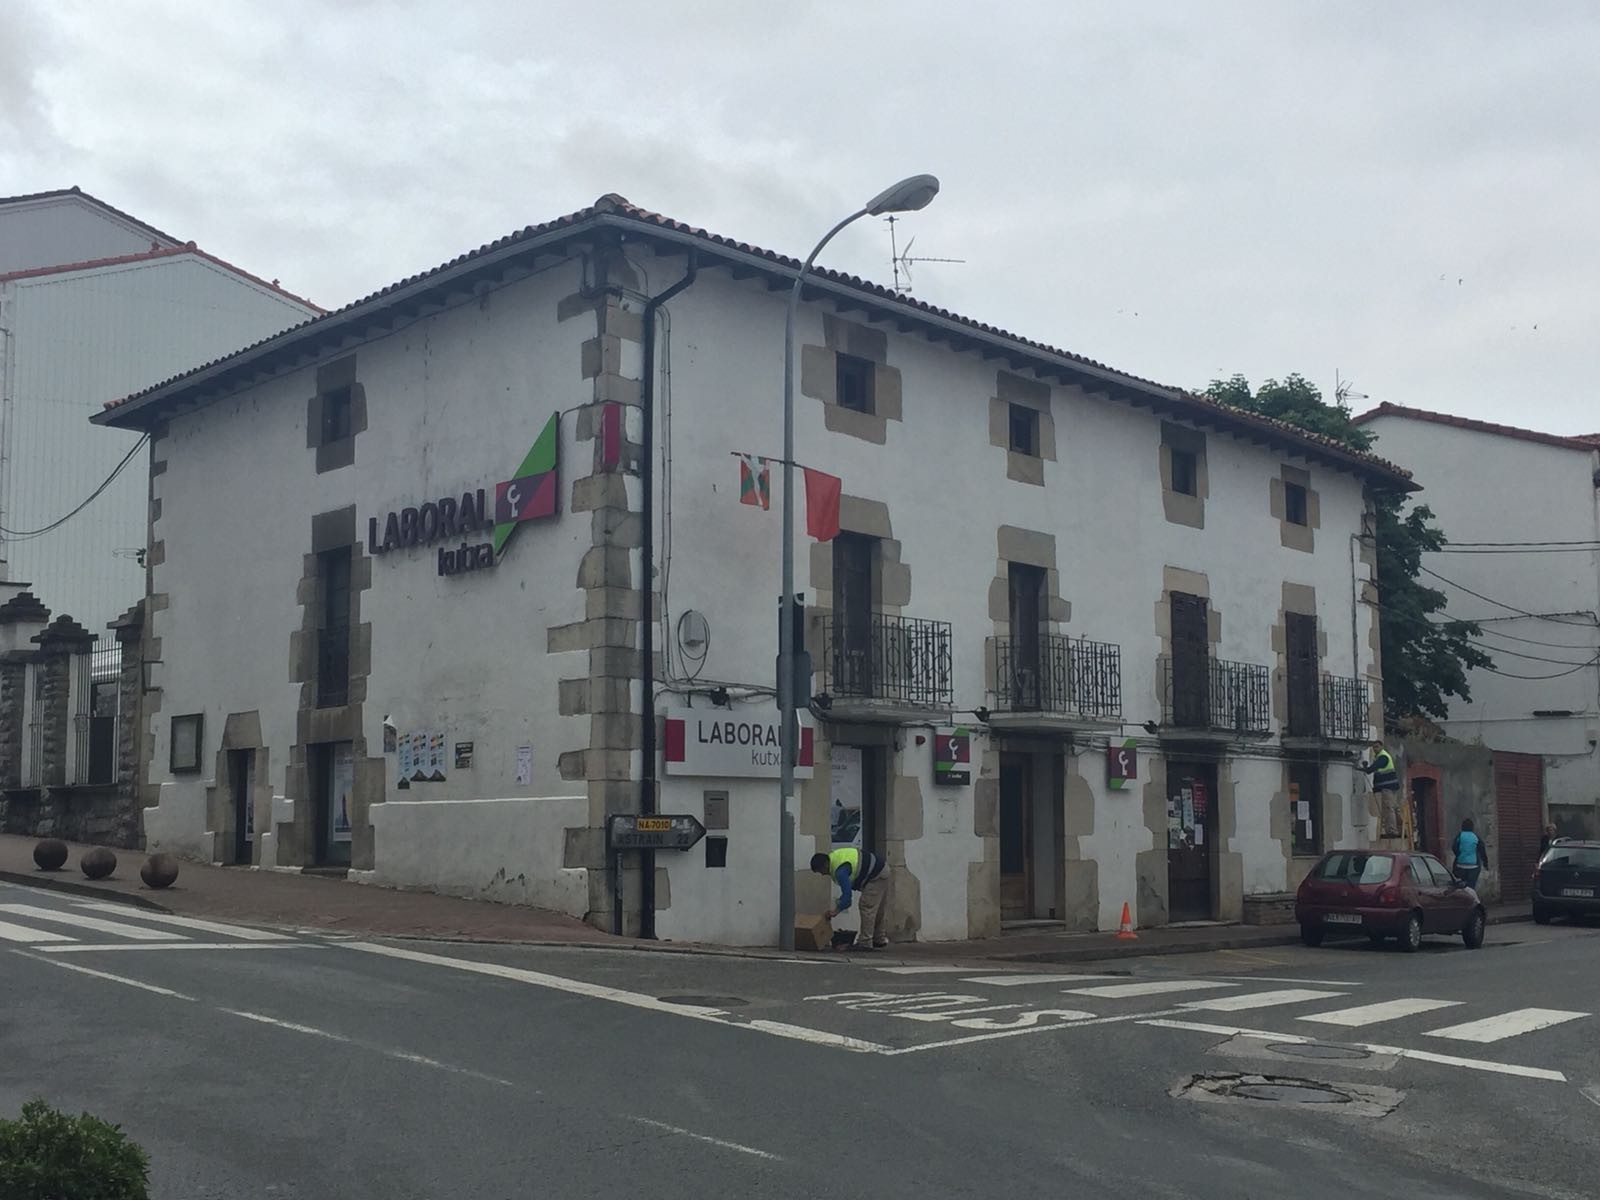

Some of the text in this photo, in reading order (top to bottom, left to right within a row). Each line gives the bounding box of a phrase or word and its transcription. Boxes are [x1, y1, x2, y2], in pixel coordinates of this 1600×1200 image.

[368, 488, 495, 555] LABORAL
[437, 542, 494, 577] kutxa
[751, 749, 782, 766] kutx
[638, 820, 669, 829] NA-7010
[802, 991, 1098, 1030] STOP
